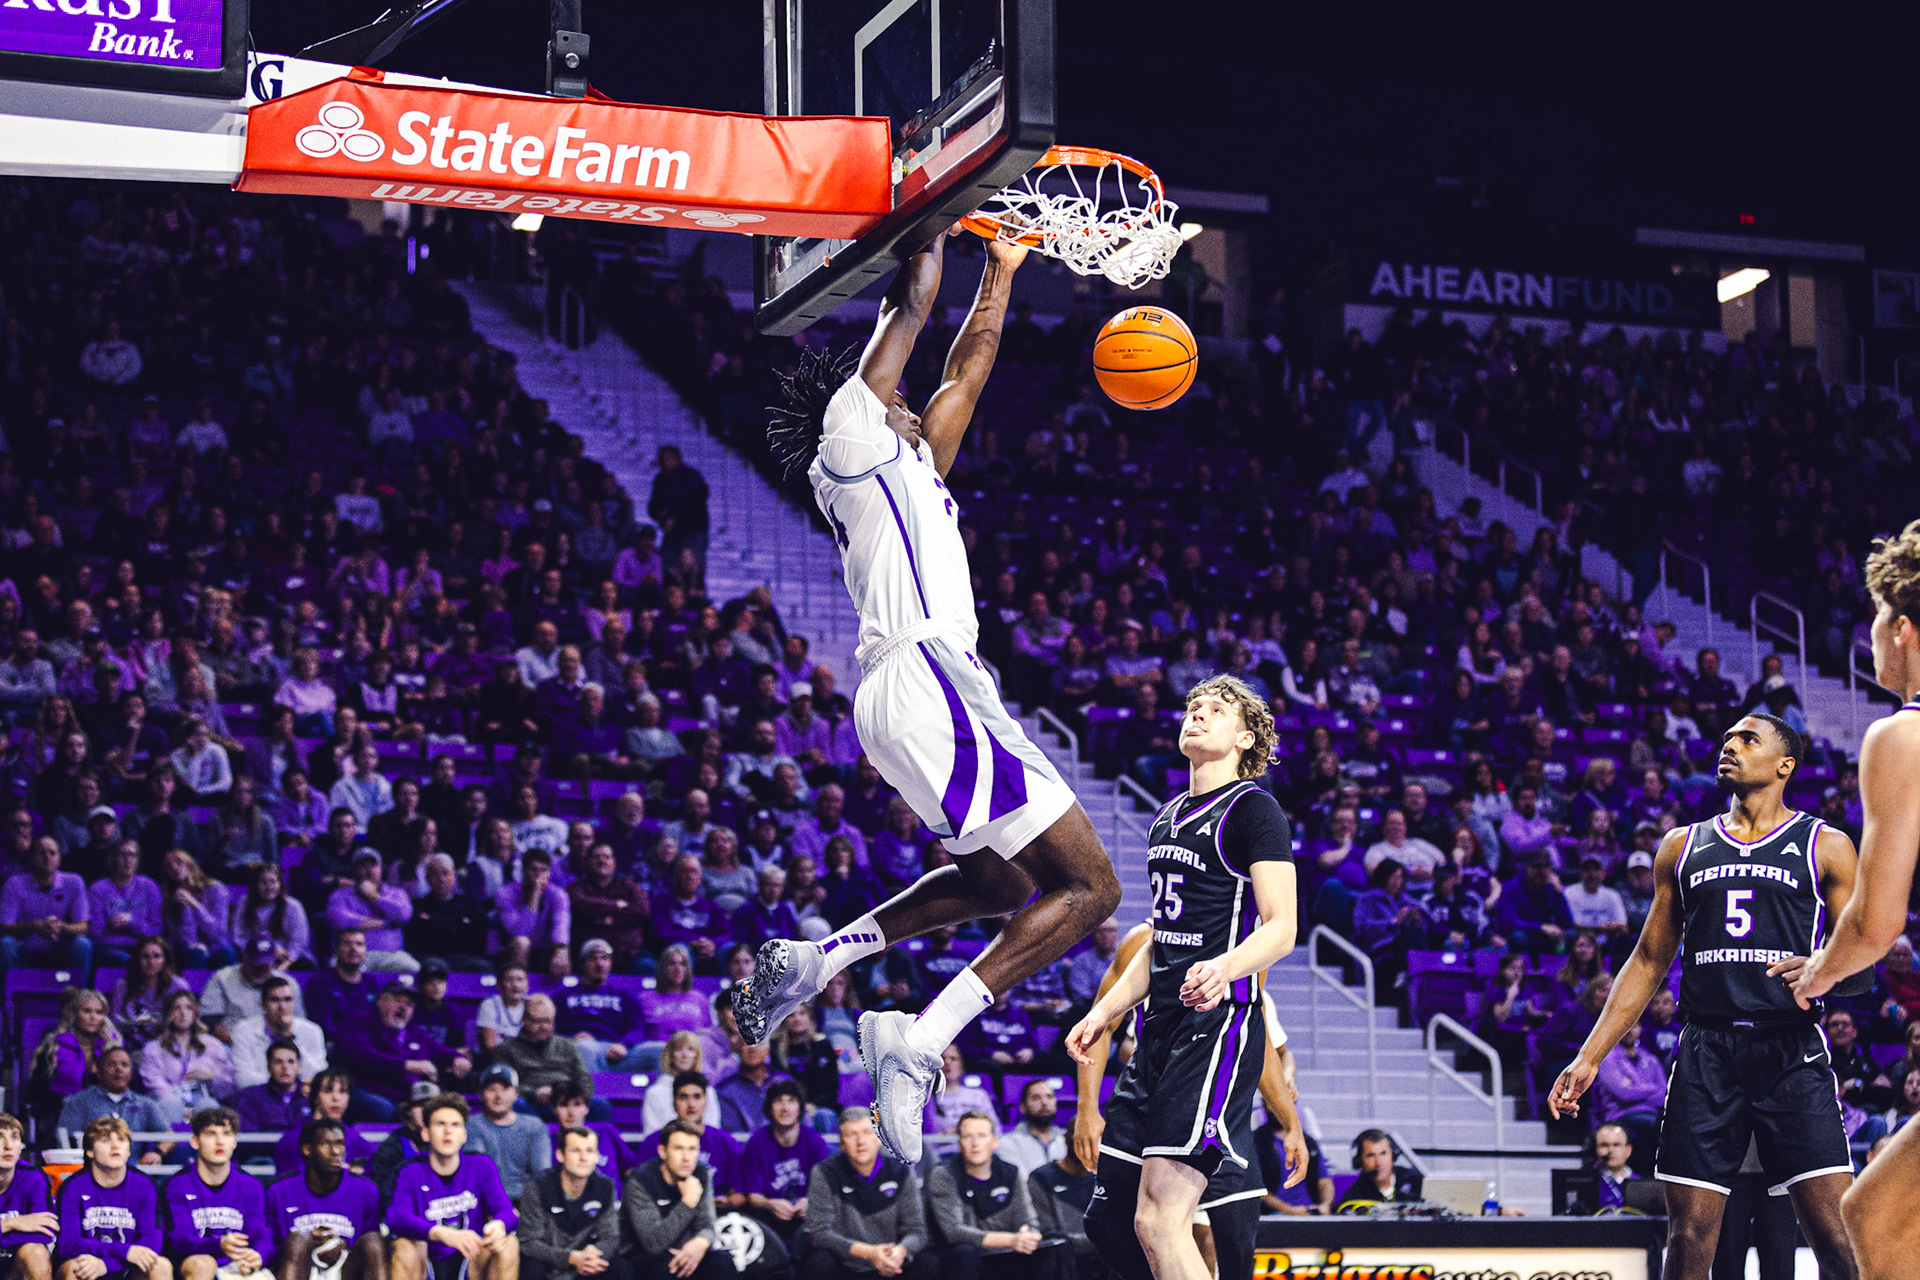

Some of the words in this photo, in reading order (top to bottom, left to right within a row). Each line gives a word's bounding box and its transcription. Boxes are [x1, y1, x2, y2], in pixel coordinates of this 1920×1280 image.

[88, 22, 183, 60] Bank
[248, 59, 284, 102] G
[1147, 844, 1206, 872] ENTRAL
[1689, 863, 1799, 889] CENTRAL
[1151, 871, 1185, 922] 25
[1725, 889, 1754, 939] 5
